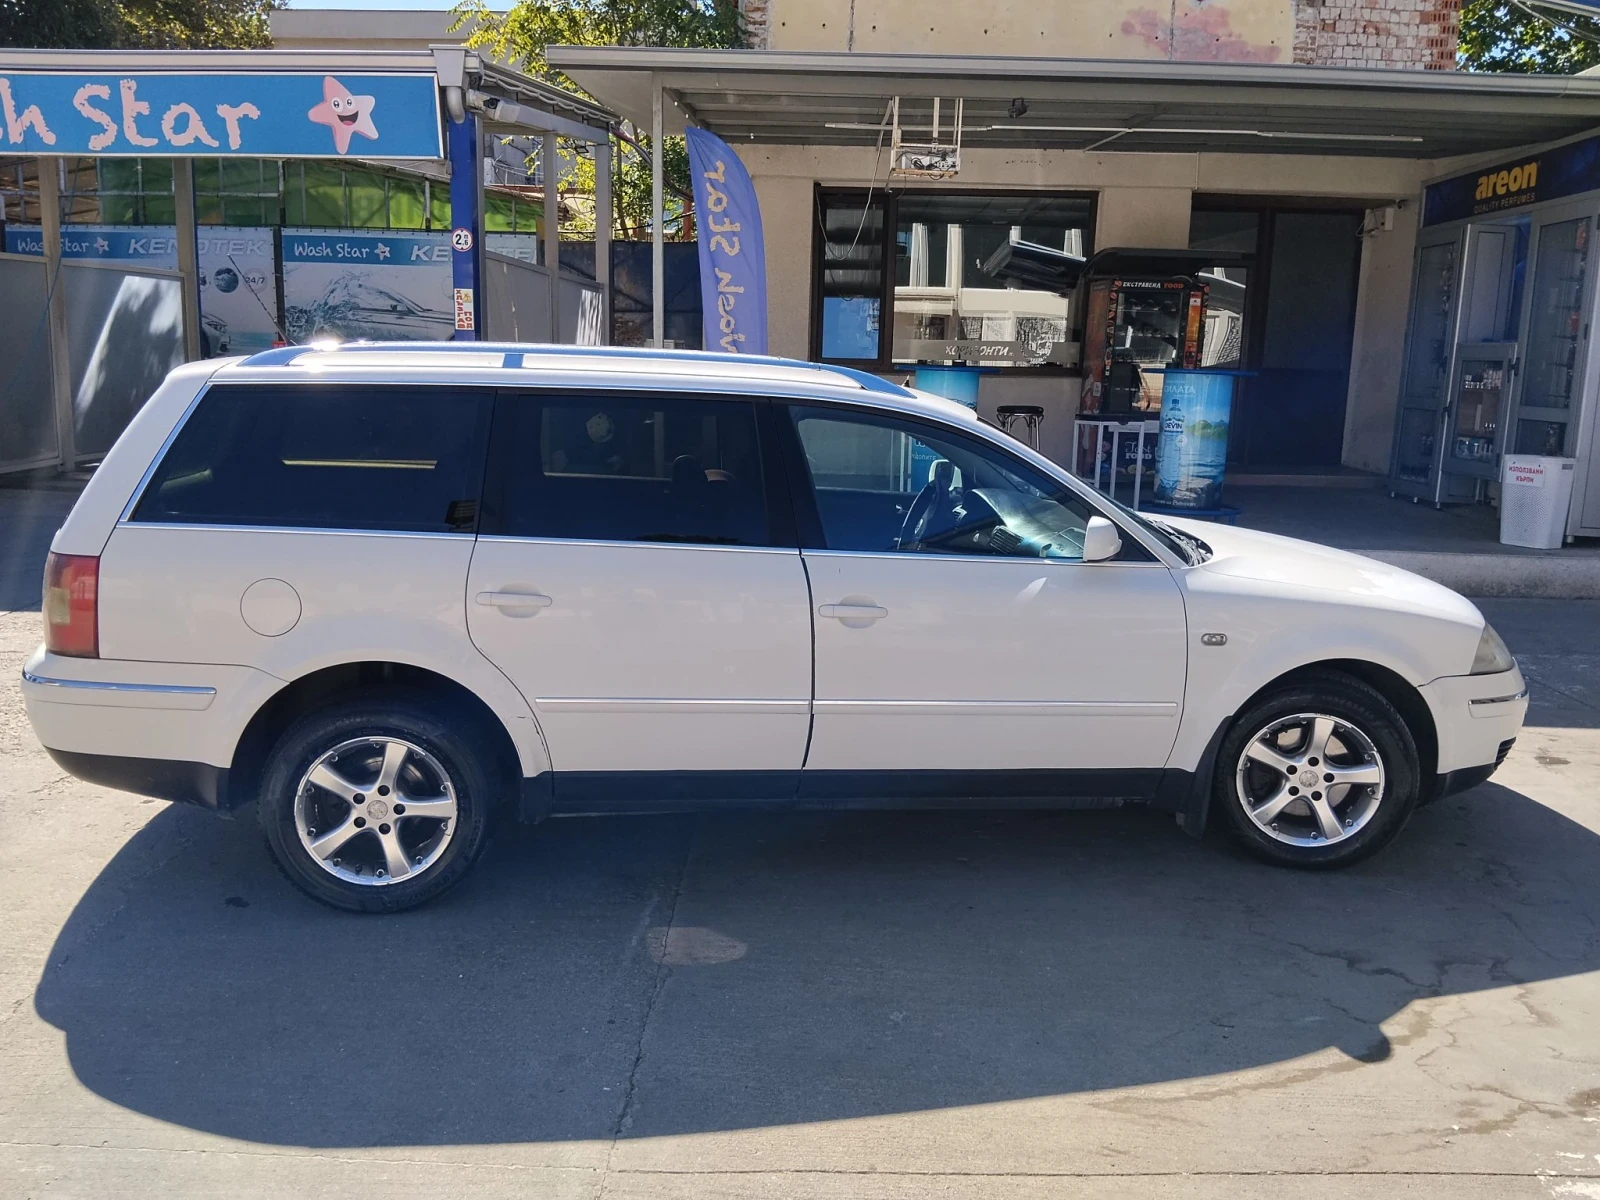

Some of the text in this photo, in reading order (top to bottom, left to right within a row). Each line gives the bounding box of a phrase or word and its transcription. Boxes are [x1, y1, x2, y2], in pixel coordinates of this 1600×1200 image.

[0, 78, 261, 150] h Star
[1475, 162, 1538, 200] areon
[1474, 192, 1536, 214] QUALITY PERFUMES
[17, 237, 44, 252] Was
[294, 242, 370, 258] Wash Star
[245, 276, 266, 285] 24/7
[456, 289, 466, 329] ХЛЪЗГАВ
[464, 311, 473, 329] ПОД
[1509, 466, 1543, 475] ИЗПОЛЗВАНИ
